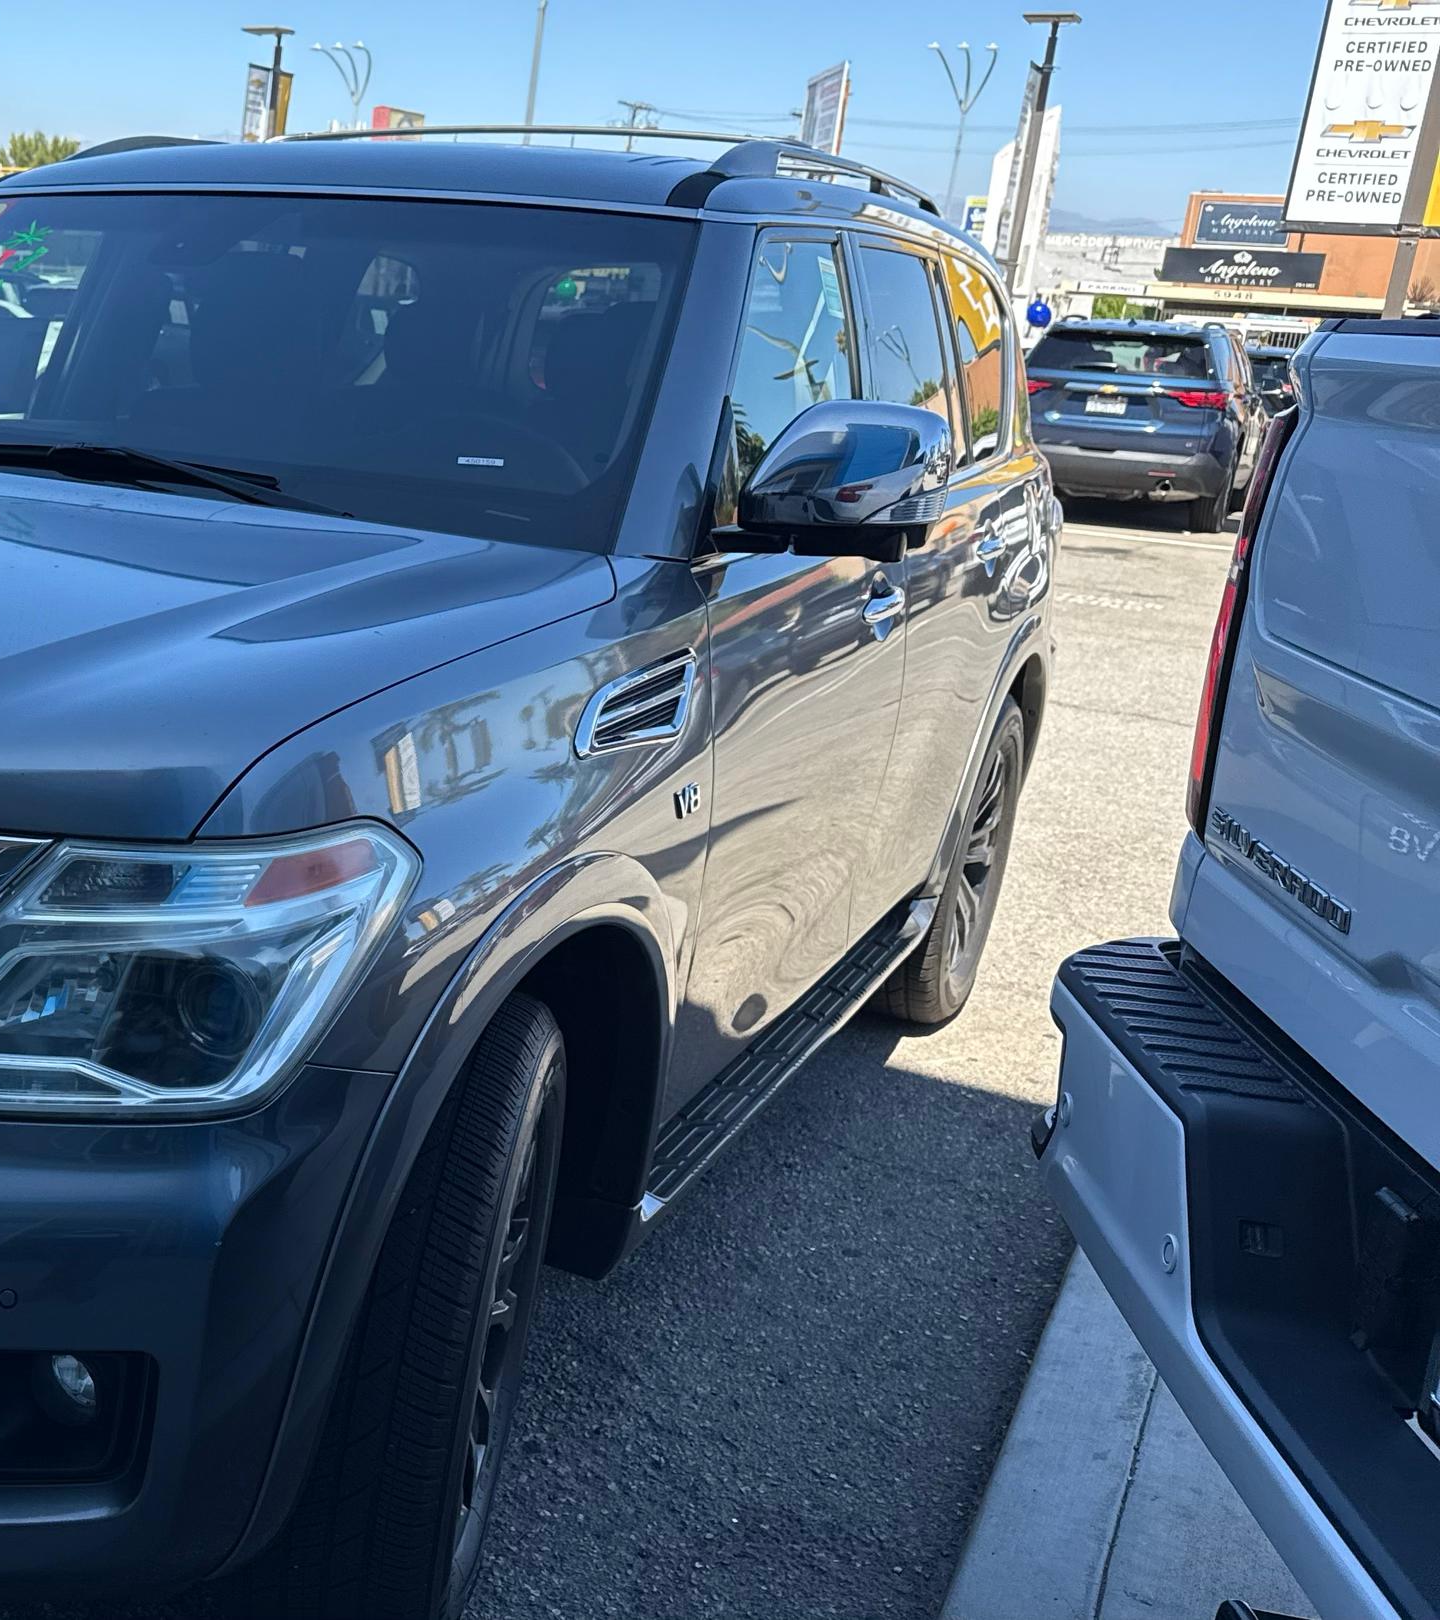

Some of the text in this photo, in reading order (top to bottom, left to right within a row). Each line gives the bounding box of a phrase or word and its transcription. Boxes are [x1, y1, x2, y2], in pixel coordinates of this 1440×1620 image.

[1345, 41, 1428, 53] CERTIFIED
[1333, 59, 1432, 72] PRE-OWNED
[1316, 148, 1411, 159] CHEVROLET
[1317, 171, 1398, 185] CERTIFIED
[1305, 189, 1402, 204] PRE-OWNED
[1211, 213, 1277, 231] Angeleno
[1212, 228, 1274, 236] MORTUARY
[1199, 259, 1282, 278] Angeleno
[1204, 275, 1273, 286] MORTUARY
[673, 782, 701, 819] V8
[1212, 805, 1352, 935] SILVERADO
